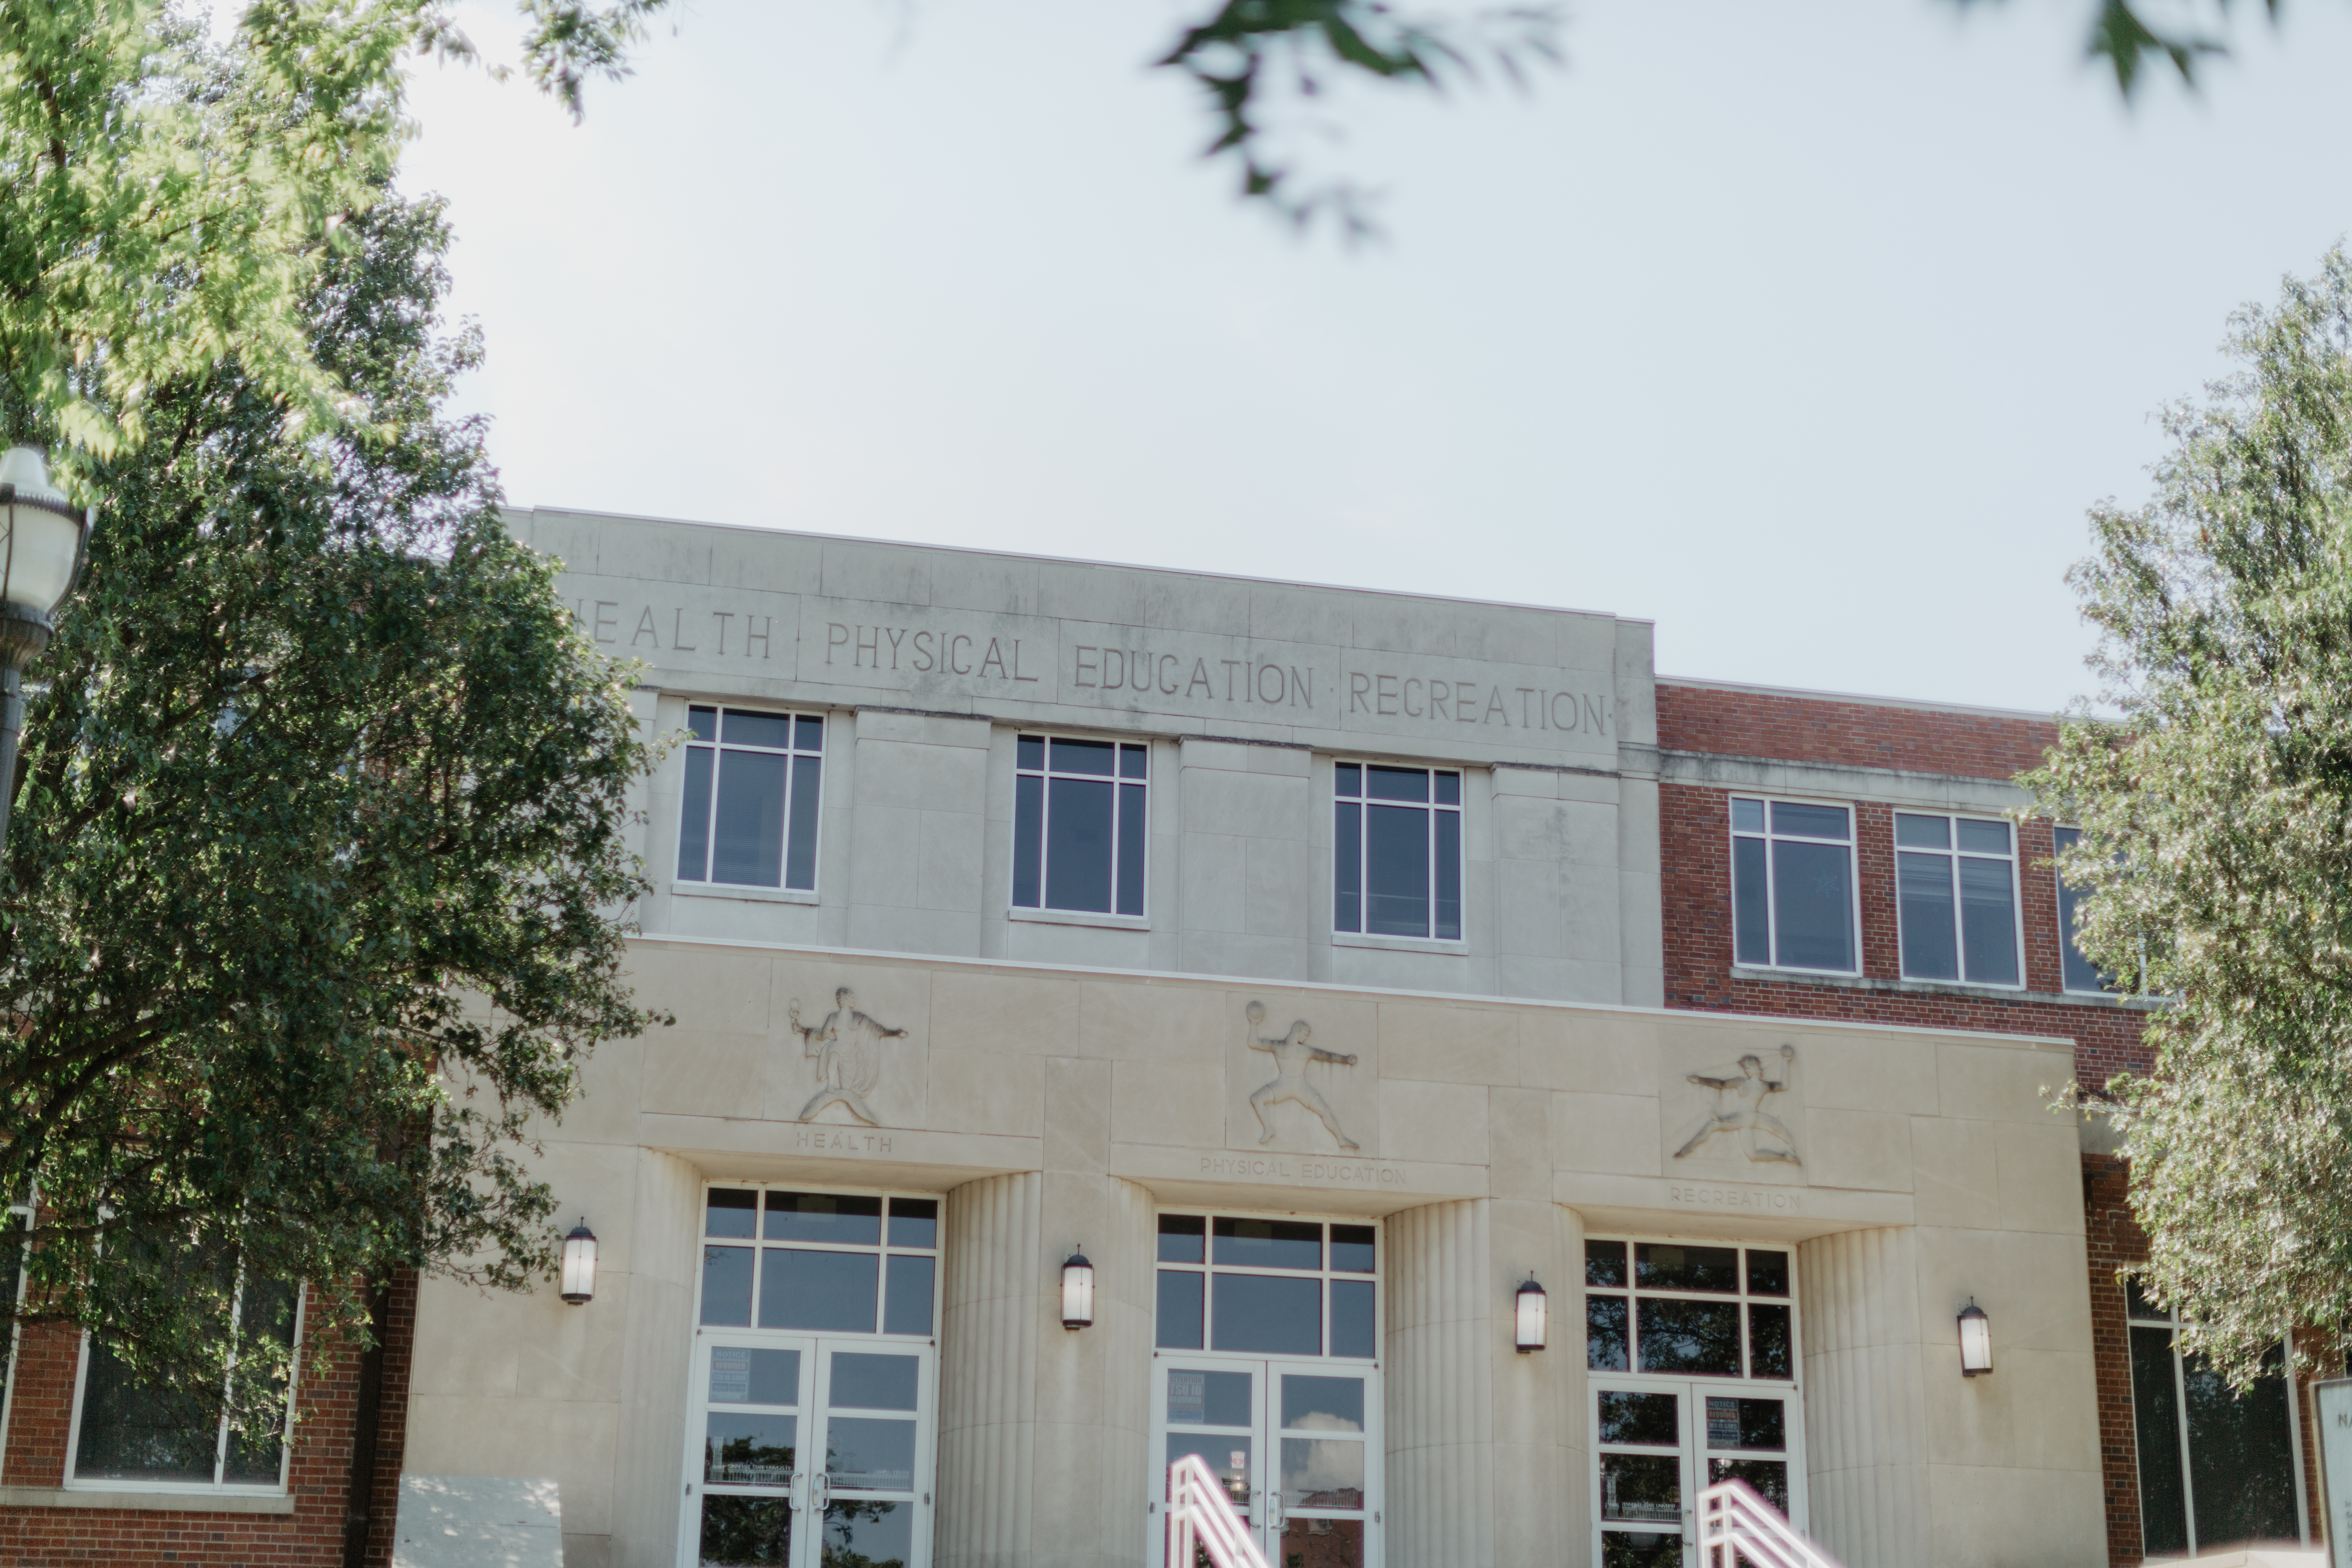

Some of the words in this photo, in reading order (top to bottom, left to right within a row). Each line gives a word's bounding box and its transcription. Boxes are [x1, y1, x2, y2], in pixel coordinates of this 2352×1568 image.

[825, 622, 1038, 682] PHYSICAL
[1074, 645, 1314, 709] EDUCATION
[1348, 672, 1606, 734] RECREATION
[797, 1132, 892, 1152] HEALTH
[1200, 1158, 1290, 1177] PHYSICAL
[1302, 1164, 1406, 1183] EDUCATION
[1670, 1187, 1800, 1209] RECREATION
[716, 1350, 747, 1359] NOTICE
[715, 1361, 746, 1370] REQUIRED
[1169, 1376, 1202, 1384] ATTENTION
[1169, 1384, 1189, 1396] TSU
[1191, 1385, 1202, 1396] ID
[1169, 1396, 1201, 1404] REQUIRED
